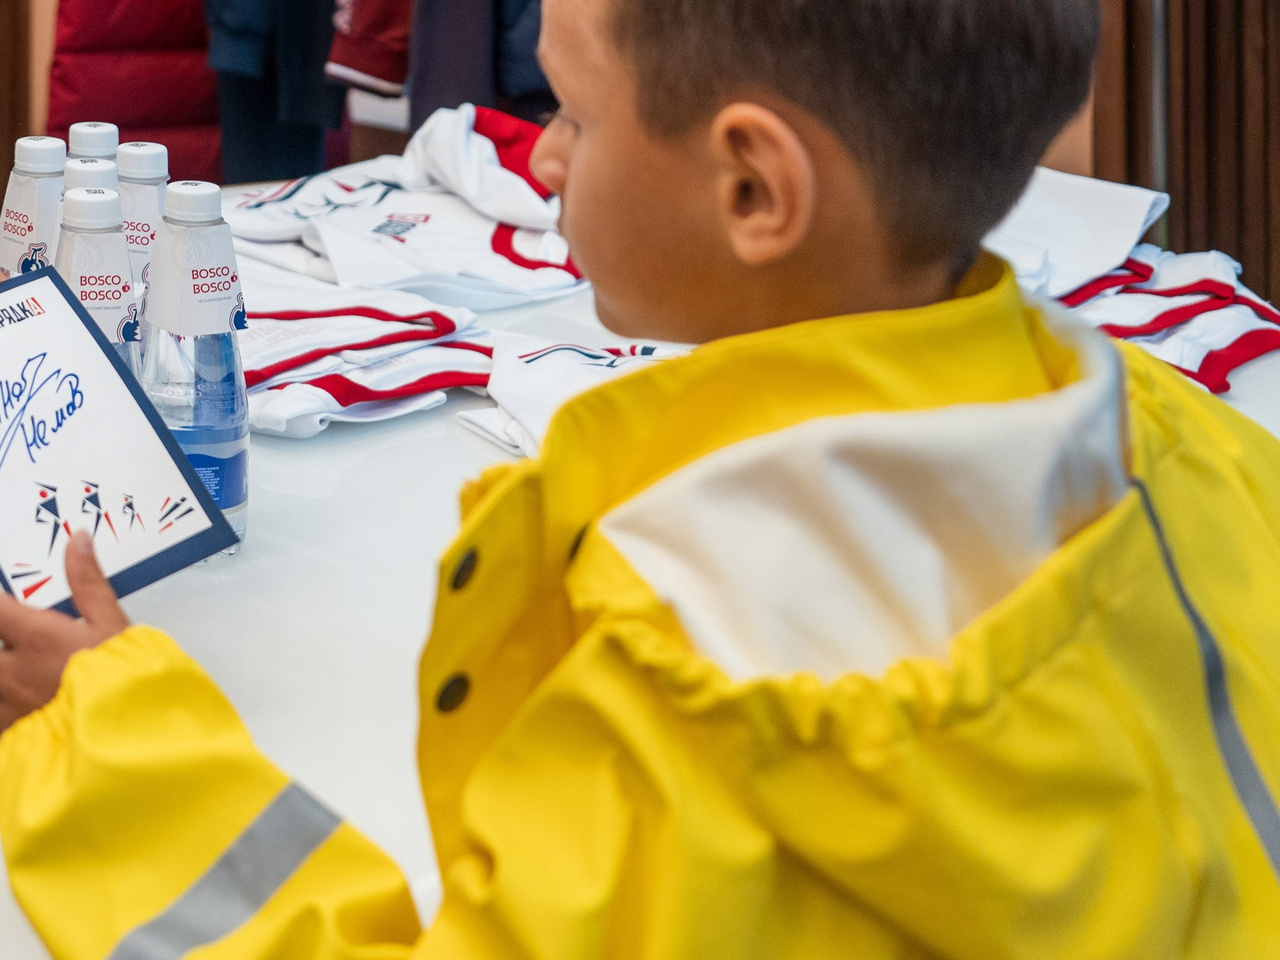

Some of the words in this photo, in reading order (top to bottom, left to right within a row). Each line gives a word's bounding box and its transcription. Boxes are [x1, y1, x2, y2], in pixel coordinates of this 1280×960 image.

[5, 209, 29, 224] BOSCO
[3, 221, 27, 237] BOSCO
[123, 220, 150, 233] OSCO
[125, 234, 150, 246] SCO
[191, 266, 230, 280] BOSCO
[80, 275, 122, 286] BOSCO
[192, 280, 231, 295] BOSCO
[80, 289, 122, 301] BOSCO
